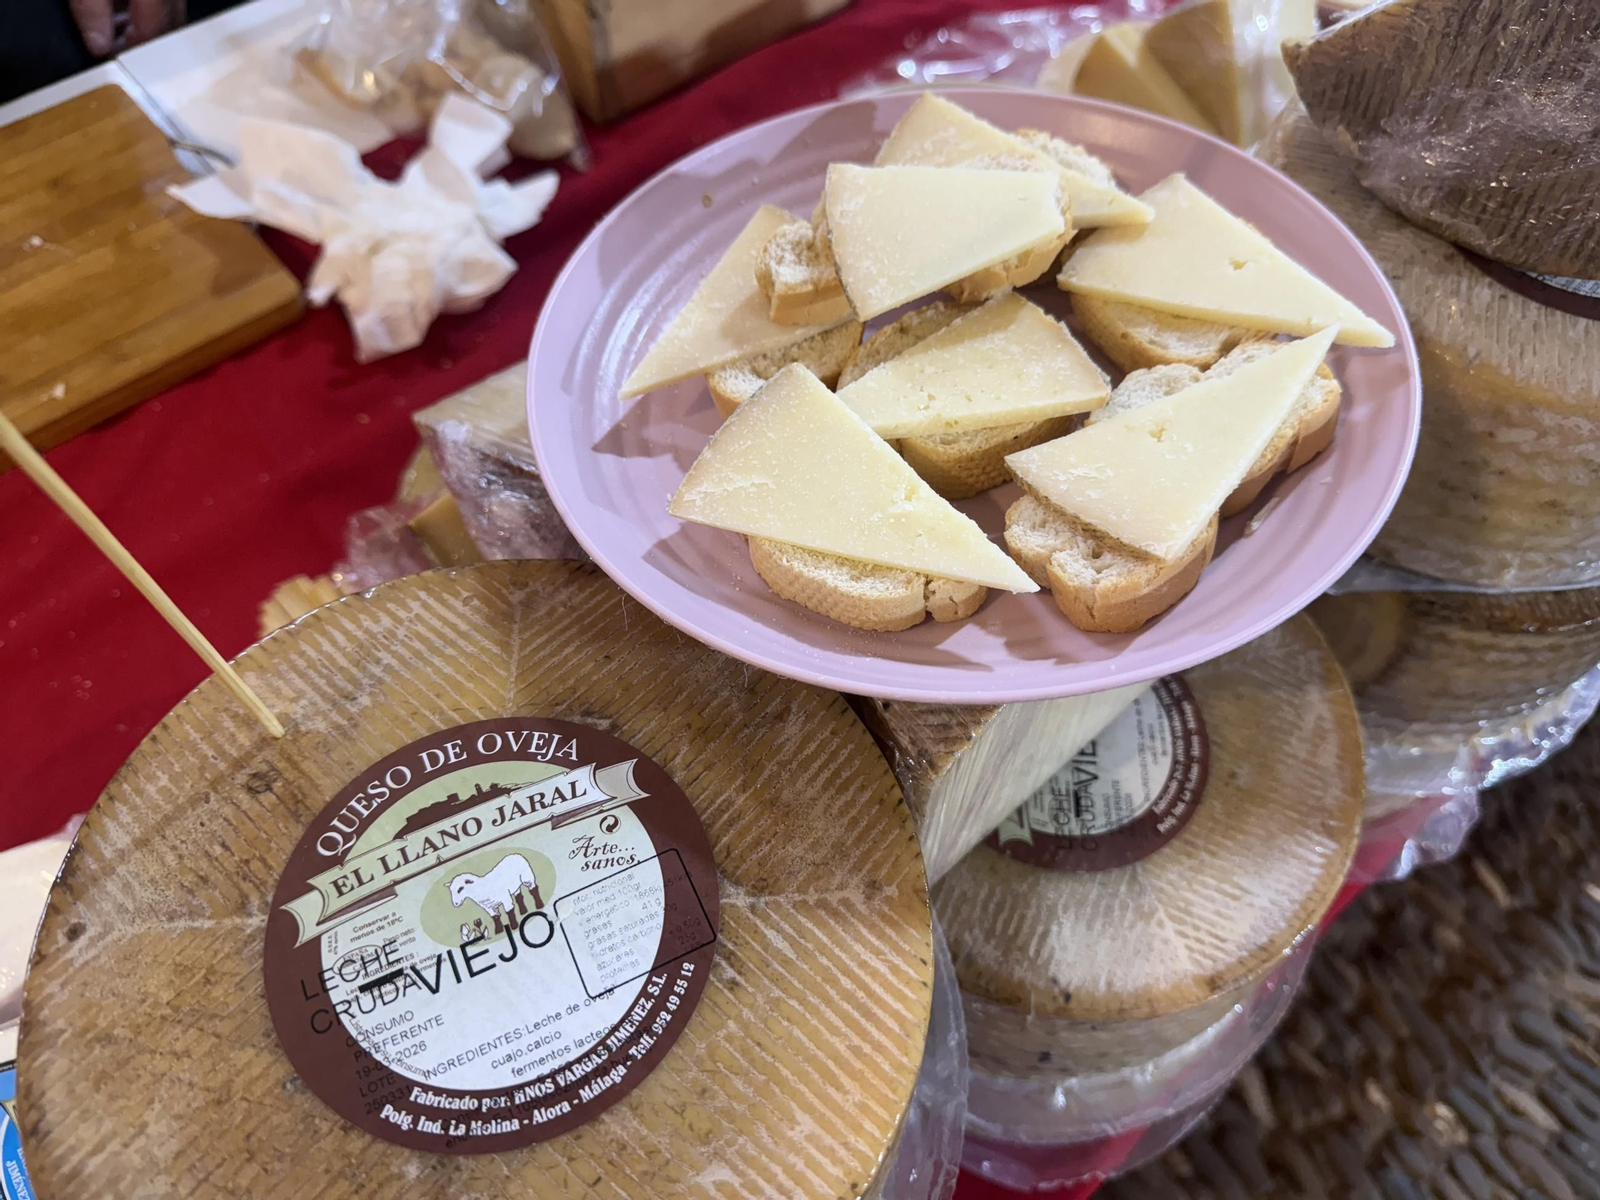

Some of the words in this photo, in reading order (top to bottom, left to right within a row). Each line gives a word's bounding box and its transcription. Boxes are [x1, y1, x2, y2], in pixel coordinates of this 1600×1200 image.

[317, 765, 411, 857] QUESO
[418, 739, 468, 773] DE
[477, 730, 578, 761] OVEJA
[329, 868, 375, 898] EL
[377, 817, 483, 875] LLANO
[491, 779, 587, 826] JARAL
[350, 930, 375, 943] menos
[376, 925, 386, 933] de
[352, 912, 390, 933] Conservar
[410, 910, 556, 995] VIEJO
[300, 939, 404, 1001] LECHE
[680, 961, 695, 977] 12
[673, 978, 688, 995] 55
[310, 972, 422, 1034] CRUDA
[566, 1002, 580, 1016] de
[665, 995, 681, 1012] 49
[346, 1010, 414, 1048] CONSUMO
[652, 1010, 673, 1035] 952
[354, 1014, 445, 1063] PREFERENTE
[409, 1087, 478, 1110] Fabricado
[556, 1046, 609, 1088] VARGAS
[647, 973, 668, 996] S.L.
[511, 1045, 571, 1078] fermentos
[359, 1072, 397, 1098] LOTE
[578, 1061, 628, 1103] Málaga
[380, 1104, 413, 1131] Polg.
[417, 1116, 445, 1135] Ind.
[470, 1117, 520, 1136] Molina
[532, 1103, 572, 1125] Alora
[449, 1121, 465, 1136] La
